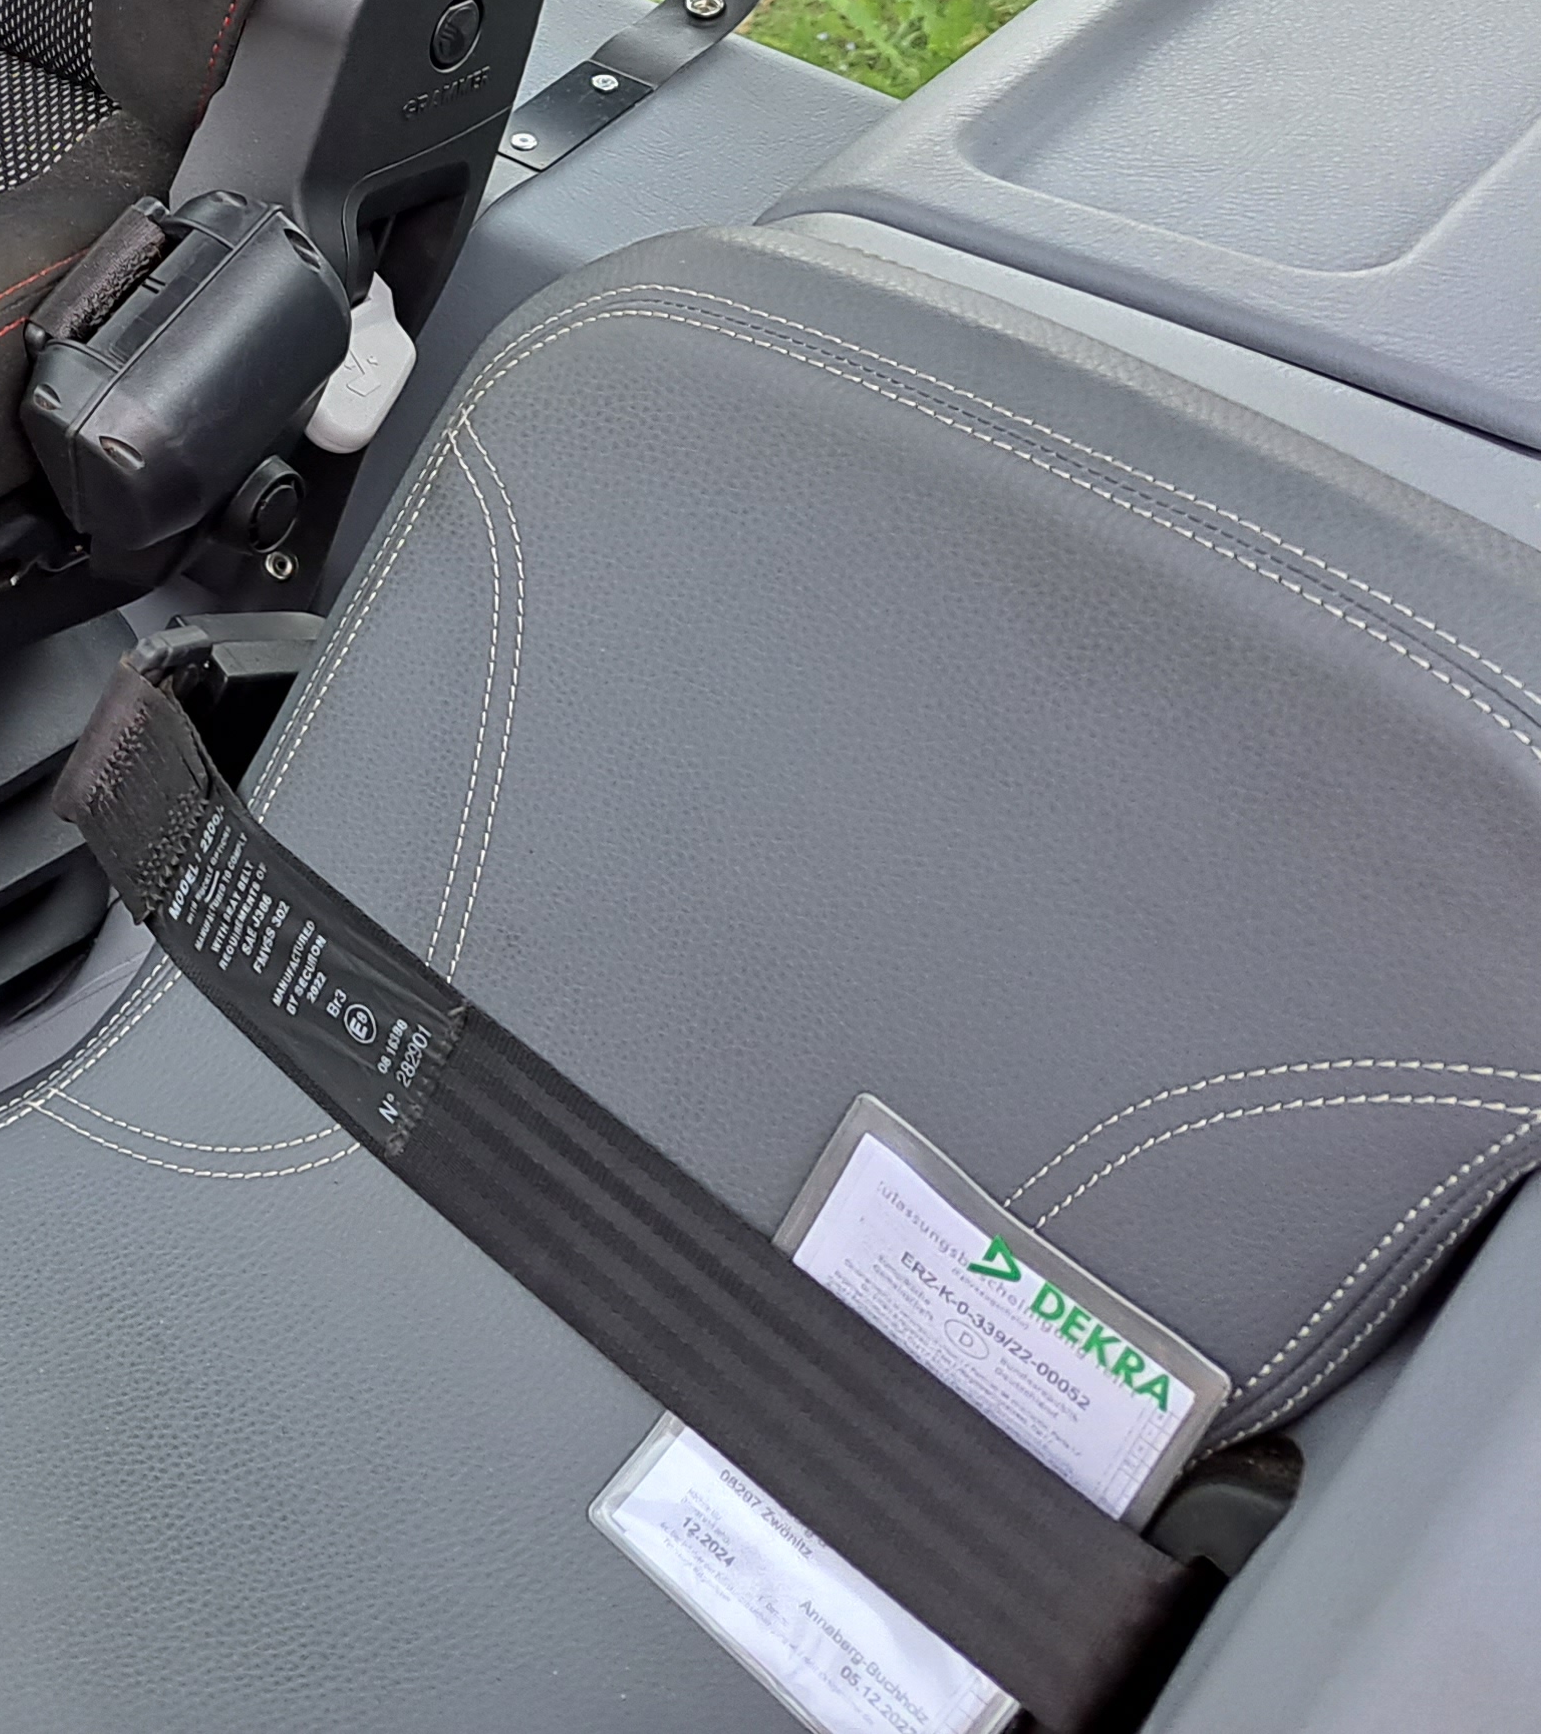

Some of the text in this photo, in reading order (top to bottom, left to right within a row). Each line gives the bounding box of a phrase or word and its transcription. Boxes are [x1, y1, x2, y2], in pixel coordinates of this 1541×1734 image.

[402, 65, 492, 119] GRAMMER
[167, 863, 199, 922] MODEL
[193, 831, 249, 953] MANUFACTURED TO COMPLY
[210, 920, 231, 954] WITH
[236, 859, 255, 894] BELT
[218, 861, 268, 972] REQUIREMENTS OF
[240, 925, 259, 957] SAE
[252, 899, 291, 976] FMVSS 302
[271, 919, 317, 1008] MANUFACTURED
[285, 933, 328, 1017] BY SECURON
[305, 971, 328, 1005] 2022
[326, 988, 348, 1019] Br3
[395, 1022, 433, 1089] 282901
[900, 1250, 1091, 1412] ERZ-K-0-339/22-00052
[957, 1332, 975, 1350] D
[1030, 1280, 1172, 1413] DEKRA
[682, 1516, 736, 1568] 12.2024
[760, 1506, 814, 1560] Zwönitz
[798, 1599, 930, 1726] Annaberg-Buchholz
